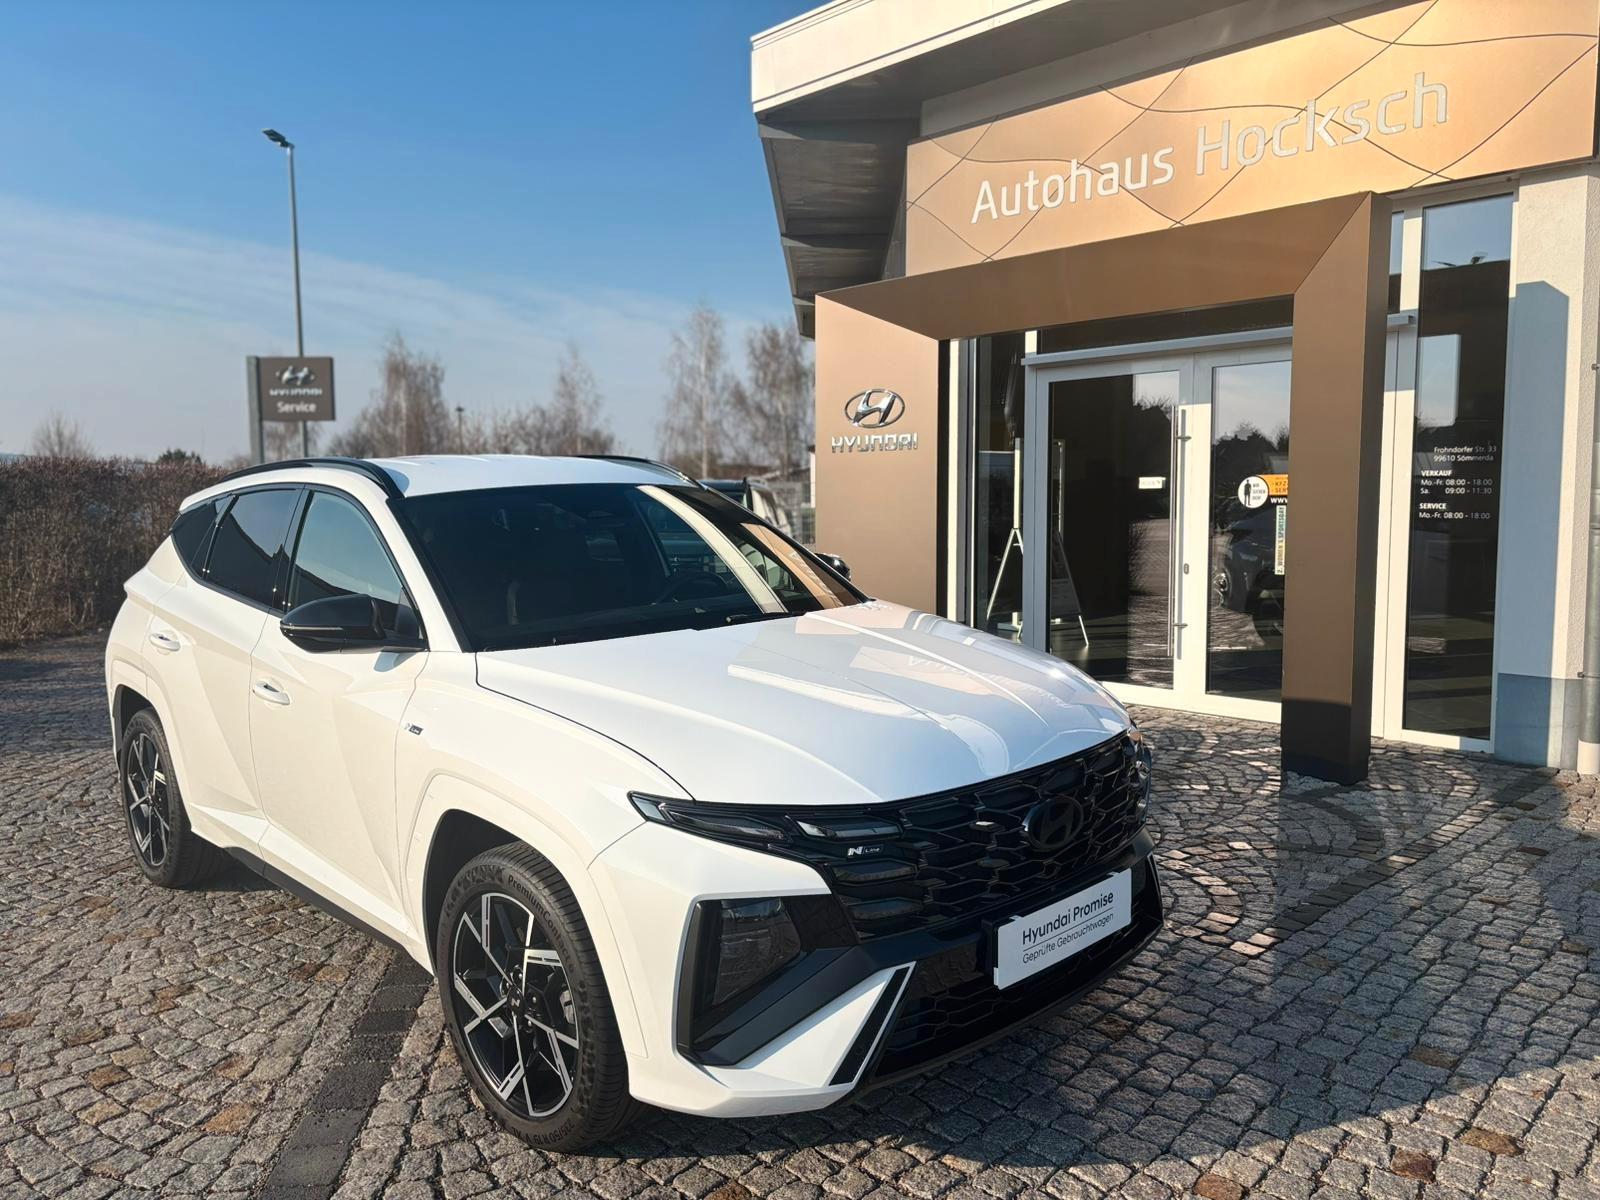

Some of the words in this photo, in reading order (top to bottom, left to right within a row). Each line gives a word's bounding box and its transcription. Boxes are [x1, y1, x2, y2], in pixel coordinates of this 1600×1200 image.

[970, 147, 1175, 225] Autohaus
[1195, 72, 1448, 176] Hocksch
[276, 401, 317, 413] Service
[831, 432, 919, 453] HYUNDAI
[1433, 446, 1473, 454] Frohndorfer
[1022, 909, 1072, 945] Hyundai
[1073, 892, 1114, 922] Promise
[1022, 942, 1056, 964] Geprüfte
[1056, 912, 1114, 948] Gebrauchtwagen
